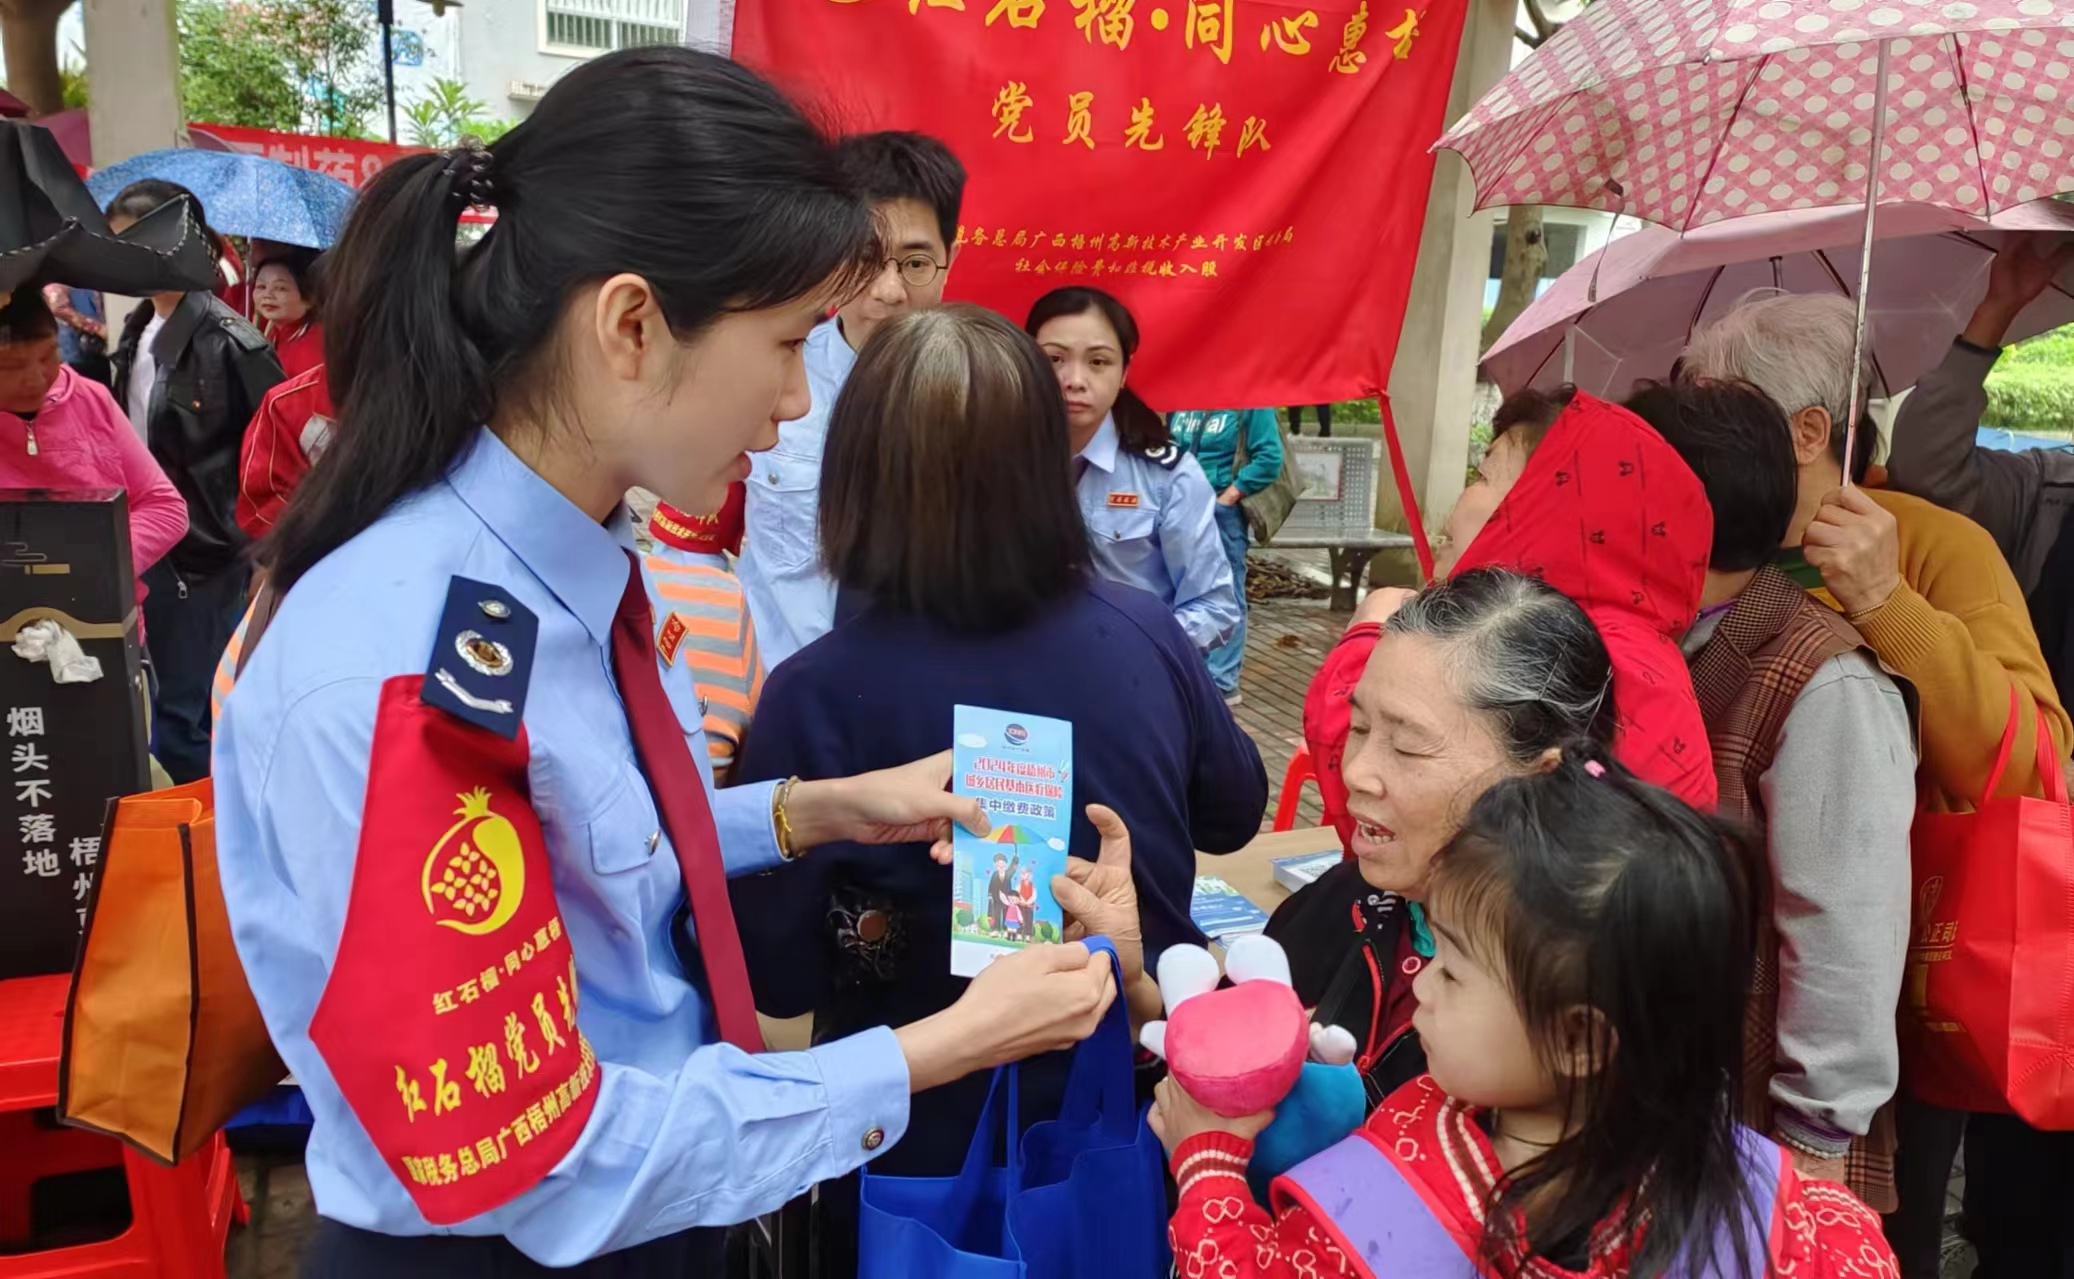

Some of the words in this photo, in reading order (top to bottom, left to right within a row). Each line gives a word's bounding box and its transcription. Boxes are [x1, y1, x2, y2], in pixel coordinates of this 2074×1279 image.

[991, 80, 1272, 161] 党员先锋队
[6, 706, 61, 877] 烟头不落地
[965, 773, 1063, 799] 城乡居民基本医疗保险
[974, 757, 1055, 779] 2024年度梧州市
[394, 953, 579, 1123] 红石榴党员先
